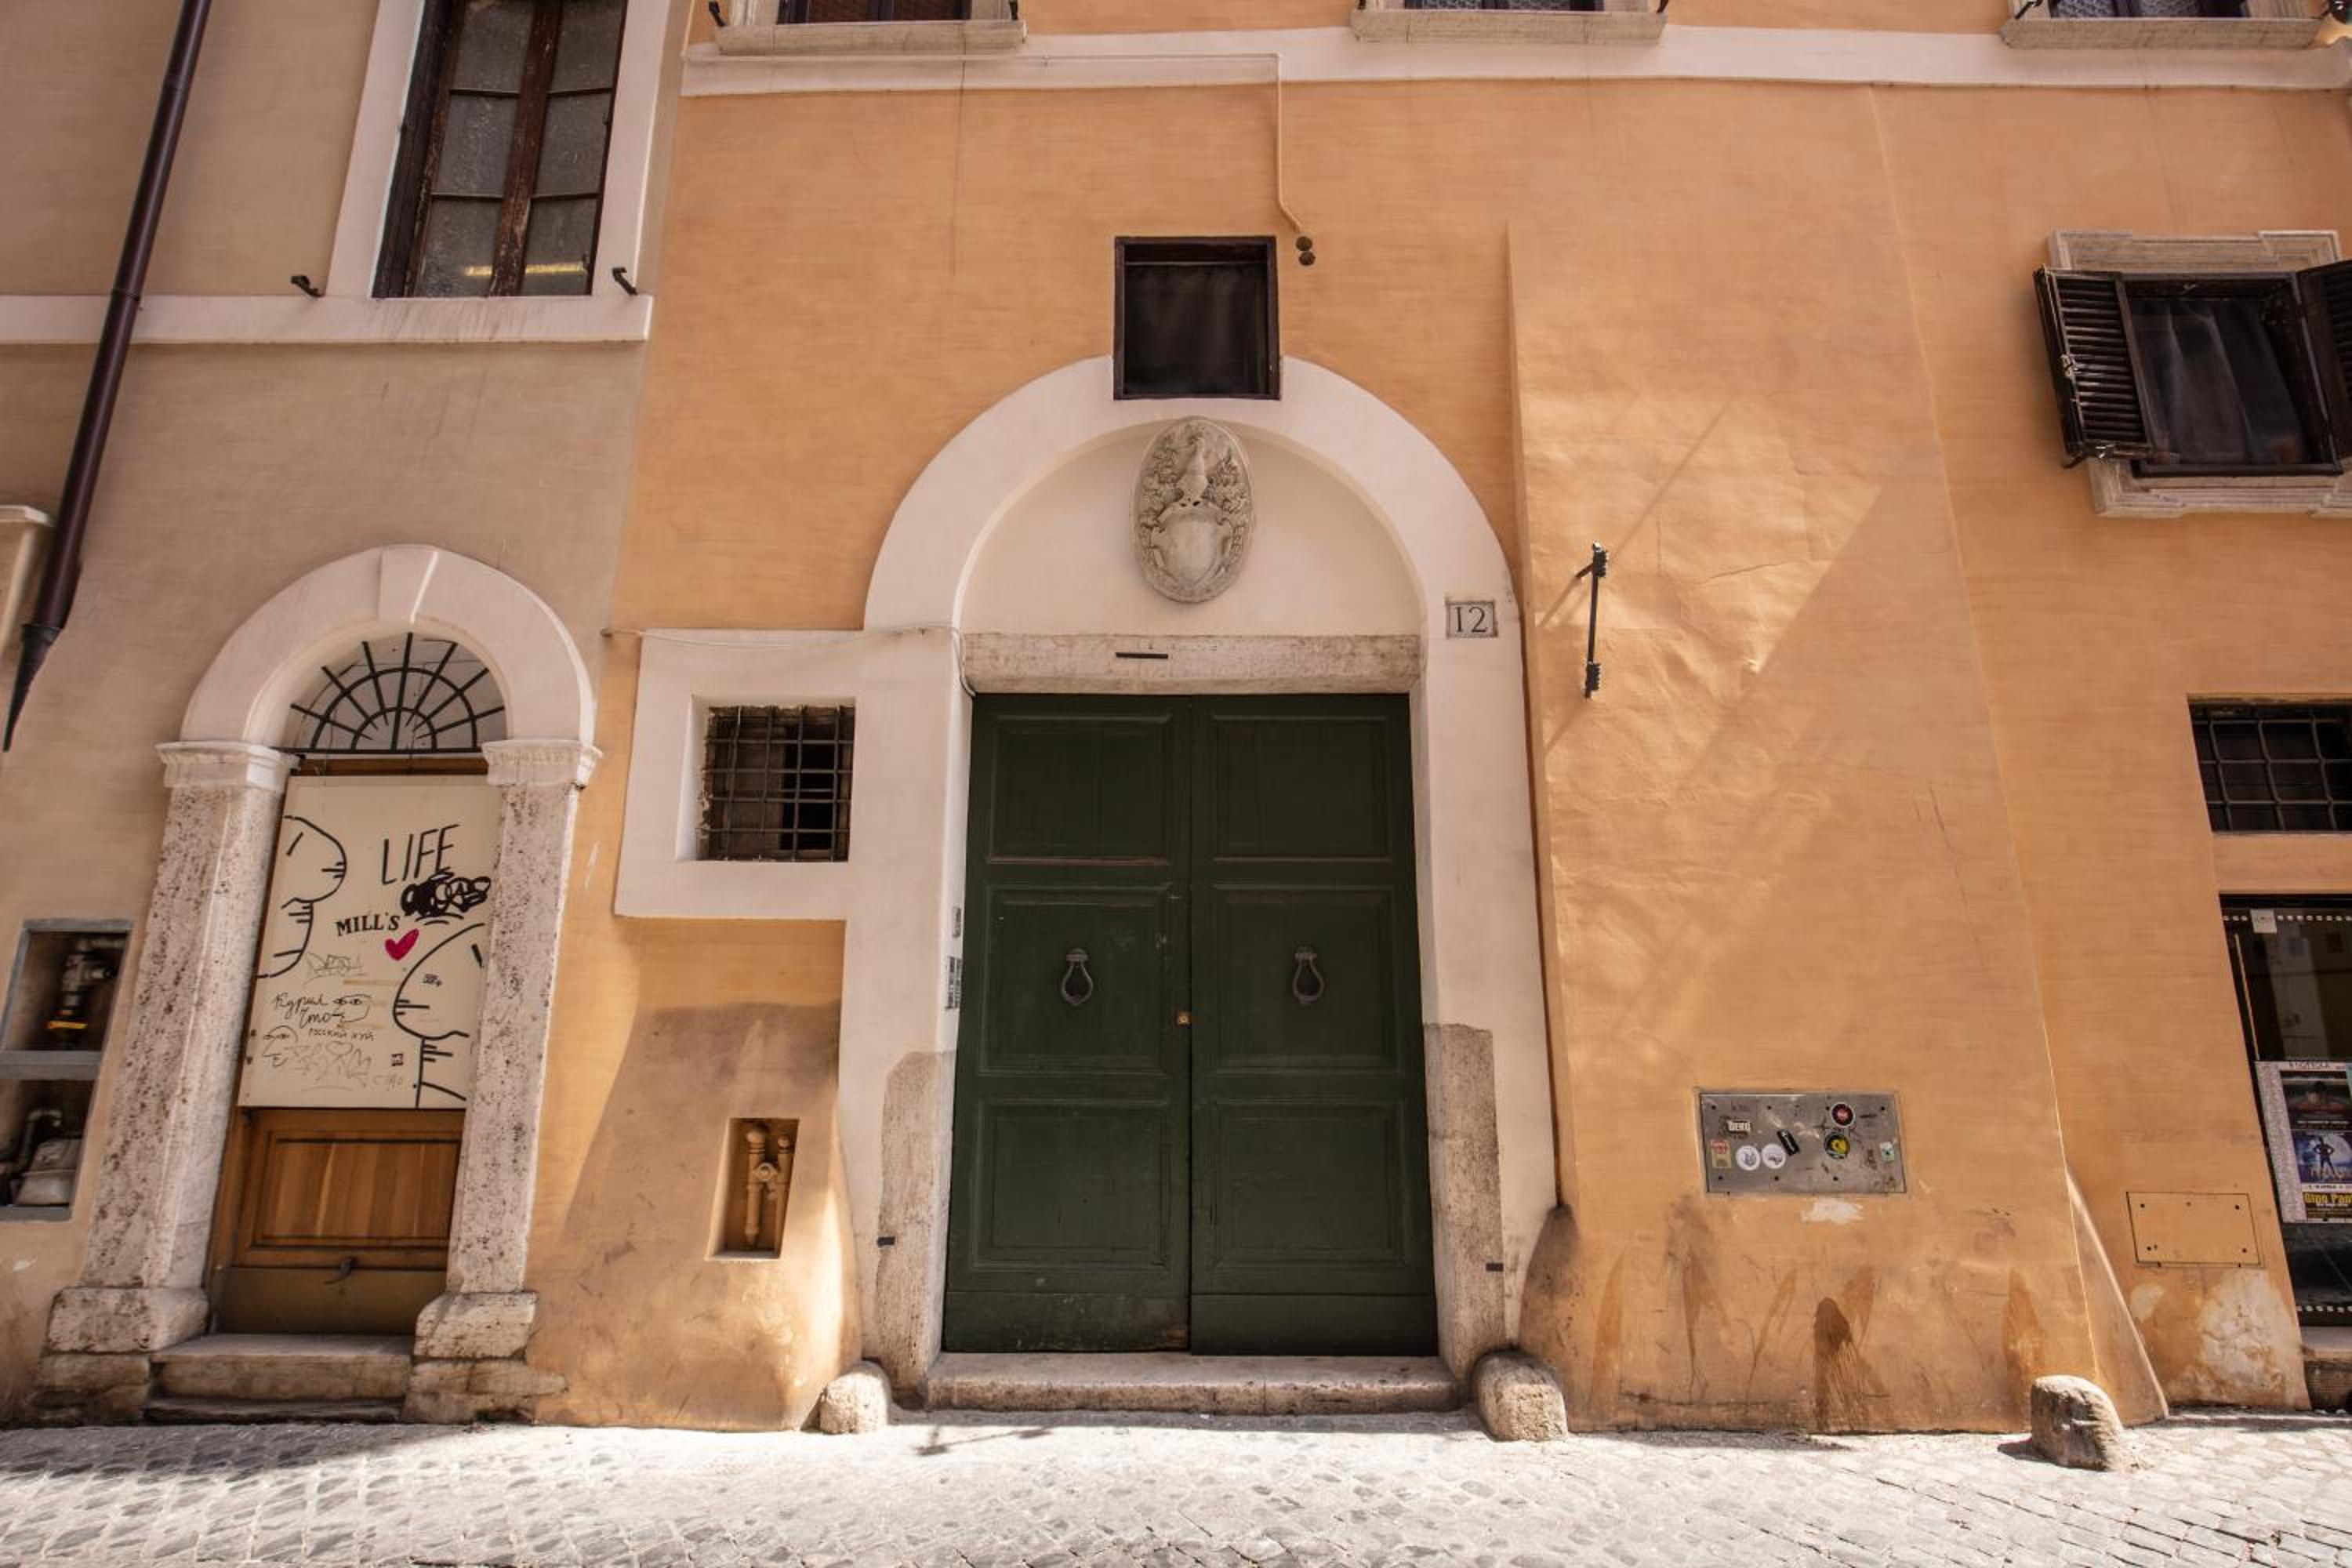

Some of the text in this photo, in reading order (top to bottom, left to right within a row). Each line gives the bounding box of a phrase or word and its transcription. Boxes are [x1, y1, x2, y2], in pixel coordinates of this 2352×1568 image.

[1454, 606, 1488, 633] 12
[381, 823, 461, 886] LIFE
[335, 912, 401, 937] MILL'S
